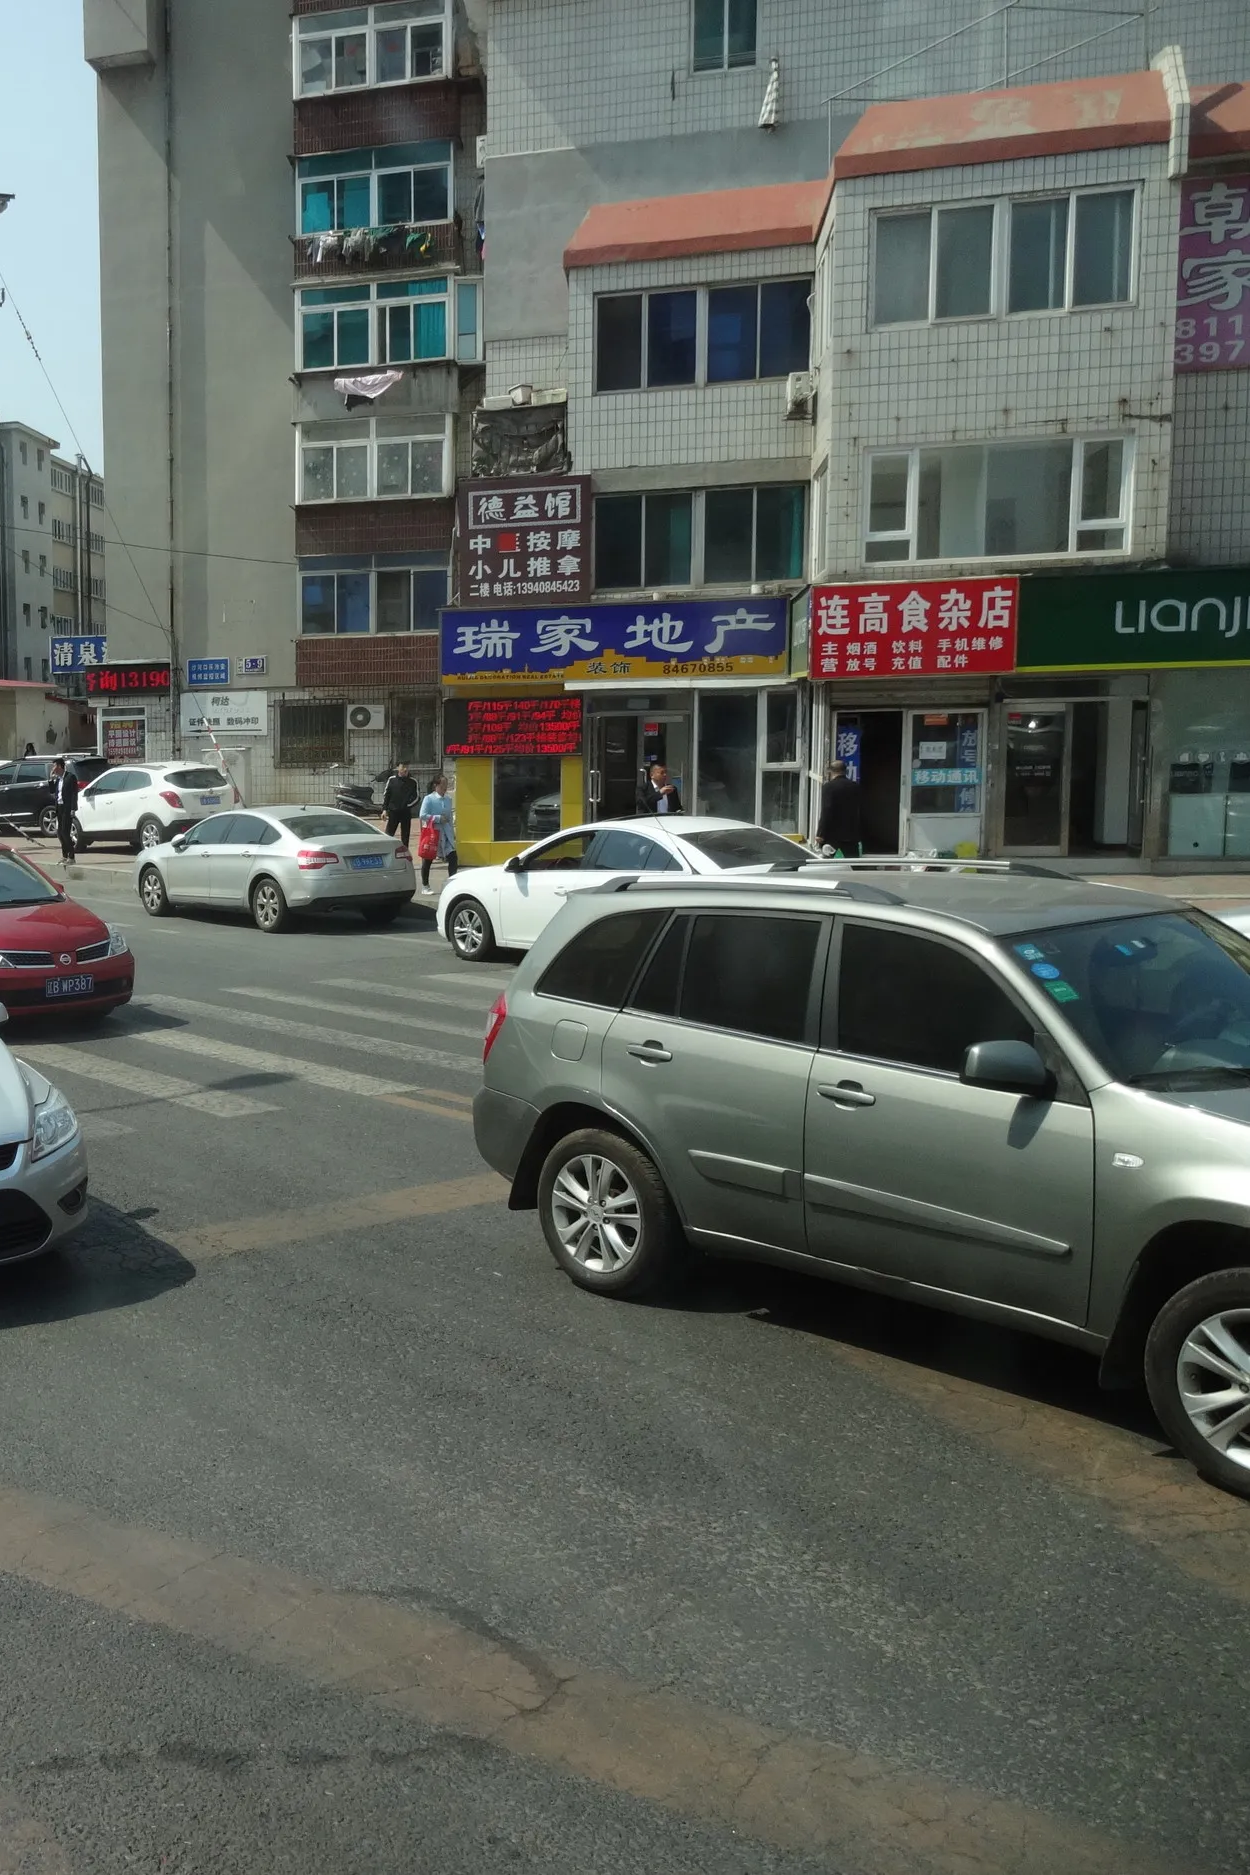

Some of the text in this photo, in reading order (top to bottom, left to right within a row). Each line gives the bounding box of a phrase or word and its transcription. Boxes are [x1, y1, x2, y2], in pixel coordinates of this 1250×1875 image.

[477, 491, 572, 524] 德益馆
[469, 529, 581, 555] 中按摩
[468, 554, 581, 580] 小儿推拿
[469, 580, 580, 598] 二楼 电话:13940845423
[817, 586, 1013, 636] 连高食杂店
[452, 607, 776, 660] 瑞家地产
[846, 636, 1004, 656] 烟酒 饮料 手机维修
[662, 661, 734, 676] 84670855
[846, 654, 969, 672] 放号 充值 配件
[915, 770, 979, 784] 移动通讯
